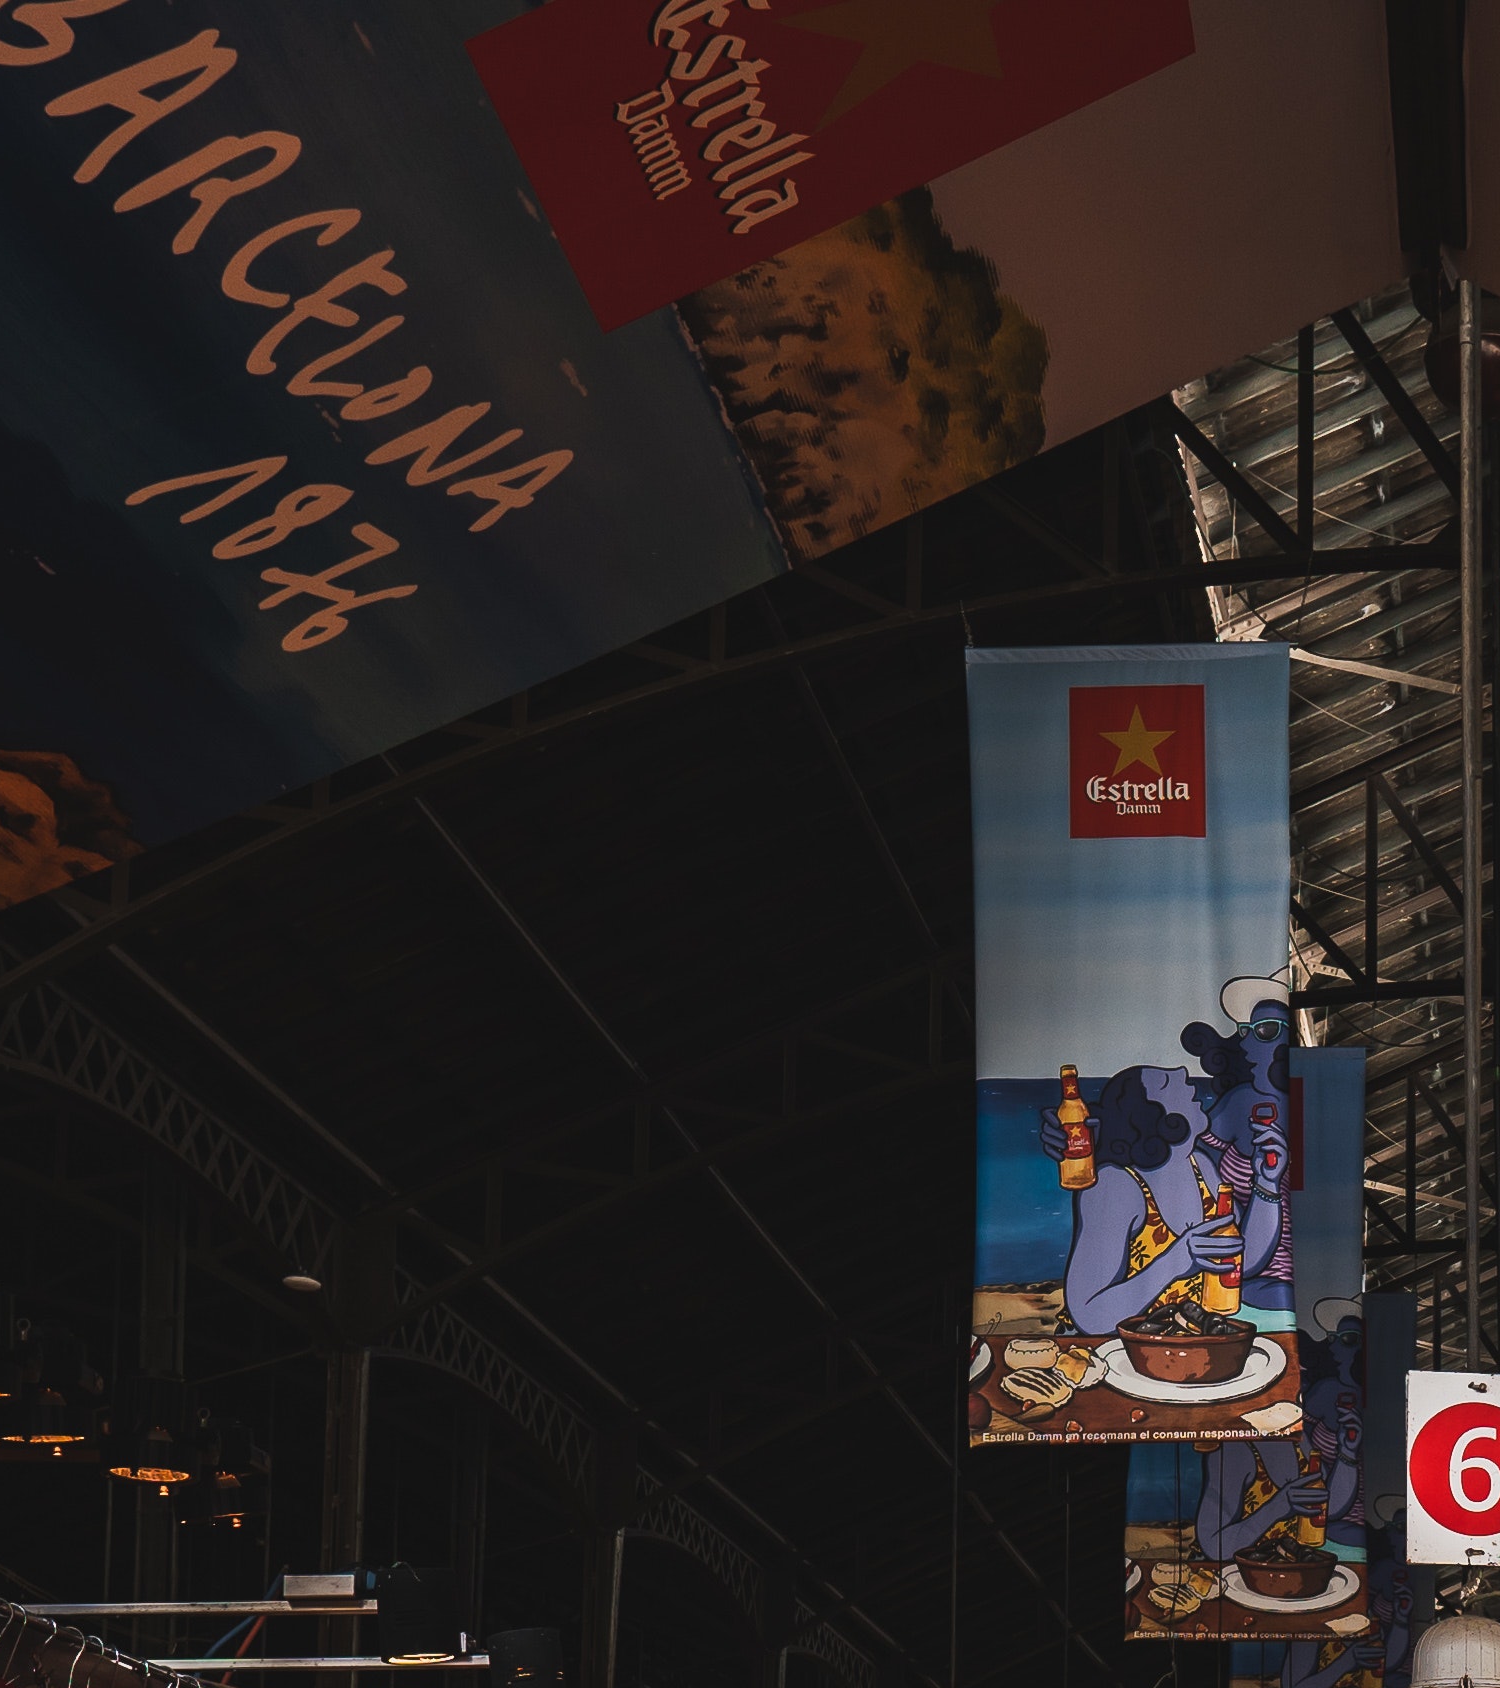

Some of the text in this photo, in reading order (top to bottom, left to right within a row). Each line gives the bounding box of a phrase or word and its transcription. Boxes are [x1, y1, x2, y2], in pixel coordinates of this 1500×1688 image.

[616, 79, 693, 201] Damm
[652, 0, 816, 234] Estrella
[125, 456, 418, 653] 1876
[1086, 774, 1191, 803] Estrella
[1116, 801, 1161, 816] Damm
[982, 1432, 1025, 1442] Estrella
[1028, 1431, 1061, 1442] Damm
[1082, 1431, 1137, 1441] recomana
[1140, 1430, 1150, 1440] el
[1153, 1430, 1197, 1440] consum
